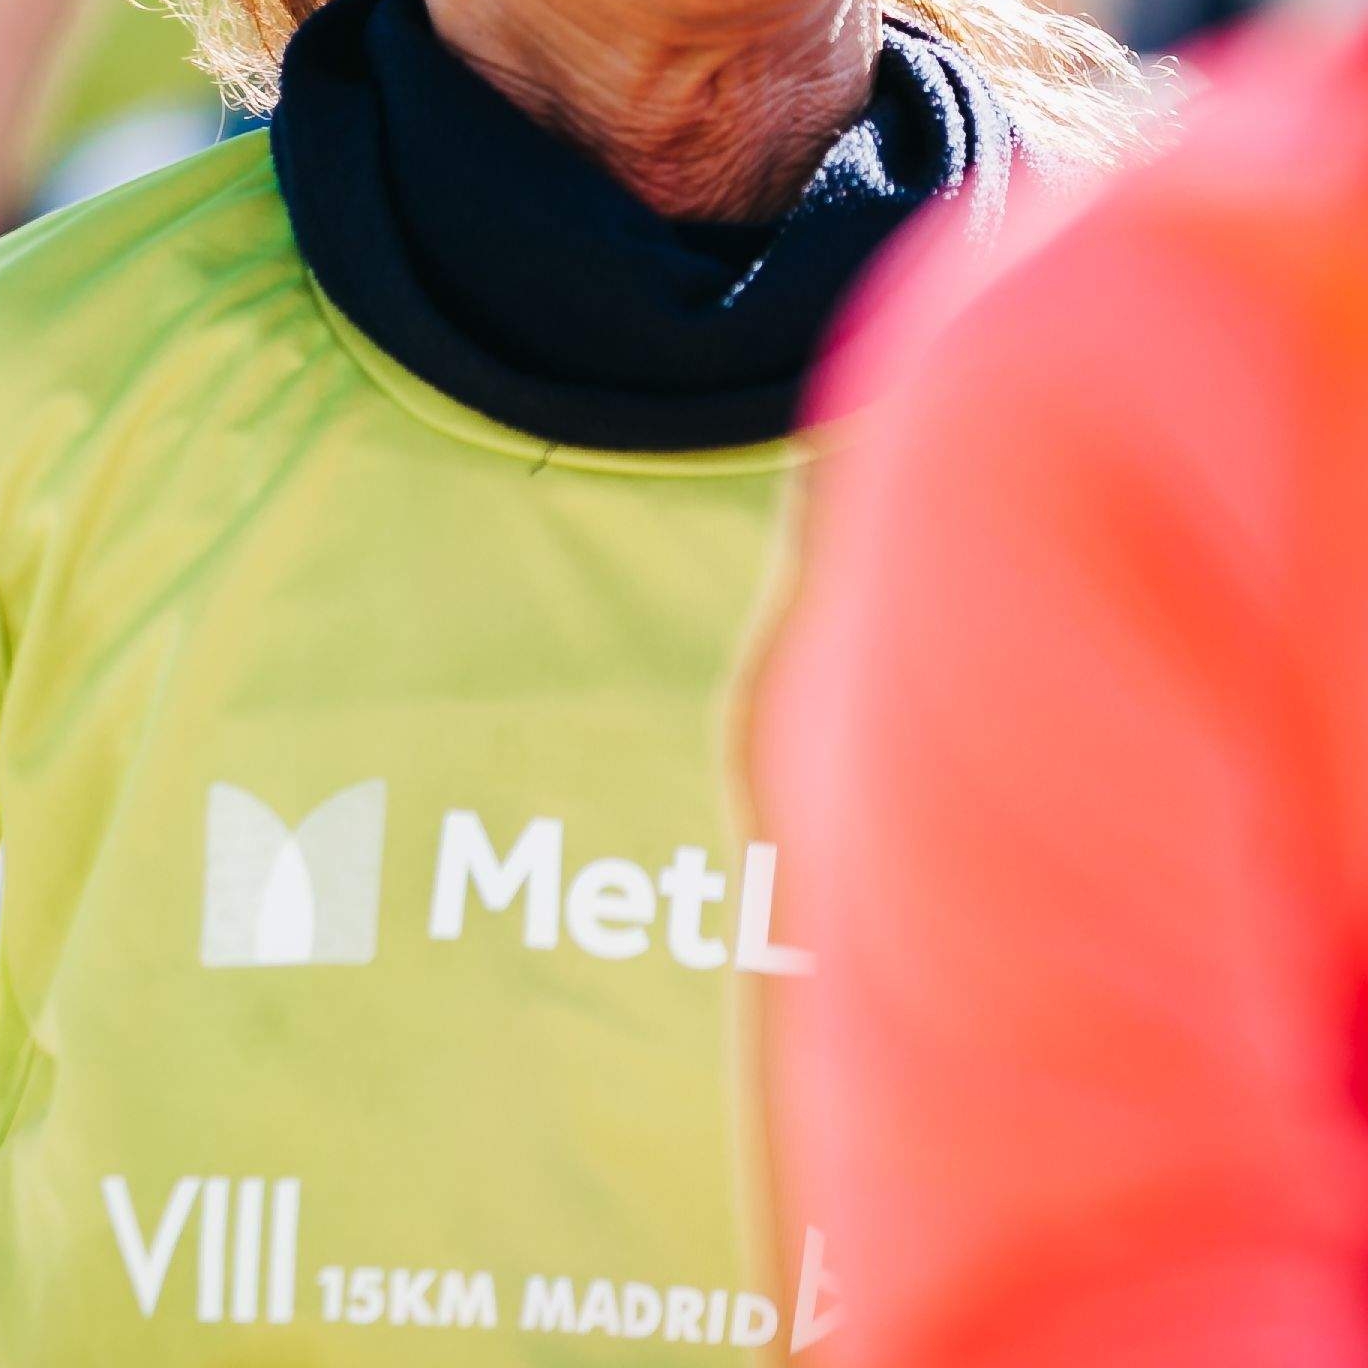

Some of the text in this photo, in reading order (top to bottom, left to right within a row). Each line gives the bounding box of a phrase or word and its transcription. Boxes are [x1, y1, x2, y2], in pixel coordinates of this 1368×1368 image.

[101, 1176, 301, 1324] VIII
[317, 1266, 499, 1328] 15KM
[520, 1274, 779, 1349] MADRID
